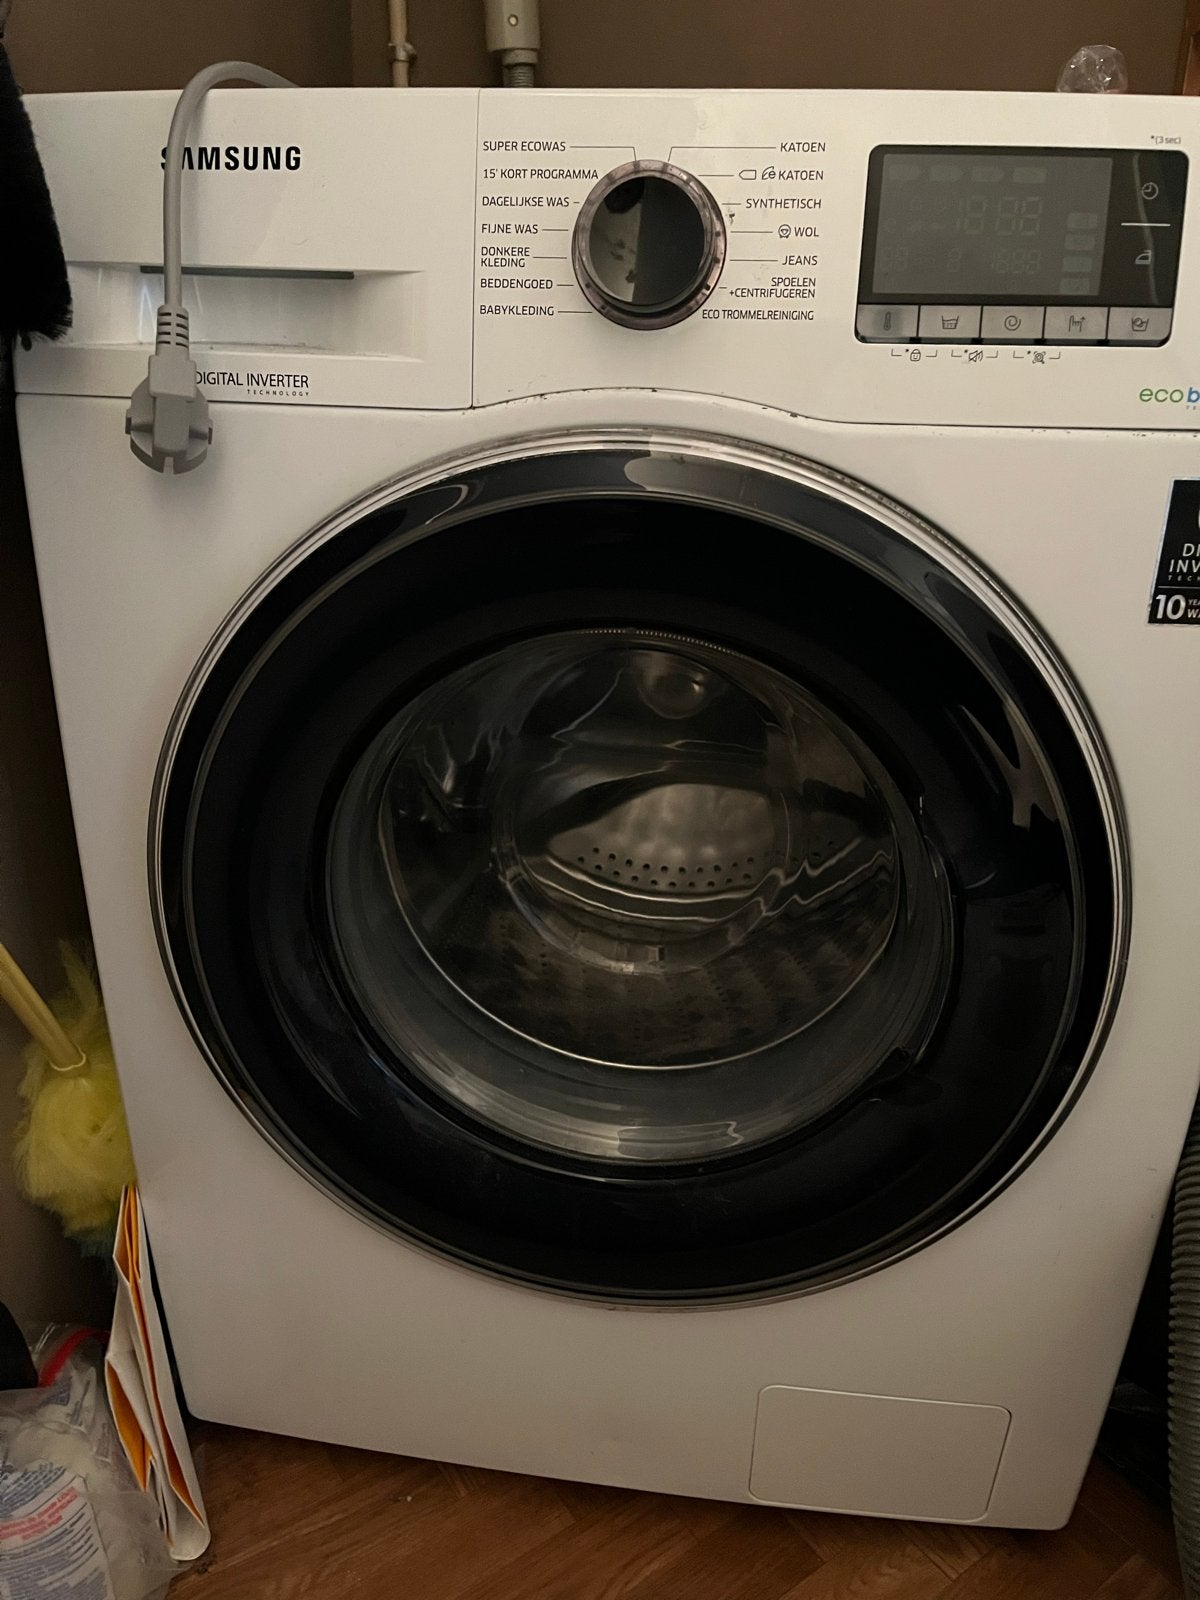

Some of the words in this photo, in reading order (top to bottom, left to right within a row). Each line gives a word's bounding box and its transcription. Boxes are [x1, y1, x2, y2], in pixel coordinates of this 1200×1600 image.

[483, 141, 518, 151] SUPER
[521, 142, 566, 151] ECOWAS
[780, 142, 826, 153] KATOEN
[161, 146, 301, 171] AMSUNG
[500, 169, 528, 179] KORT
[530, 169, 599, 180] PROGRAMMA
[778, 170, 824, 181] KATOEN
[482, 196, 544, 207] DAGELIJKSE
[546, 197, 570, 207] WAS
[746, 198, 822, 209] SYNTHETISCH
[481, 224, 512, 234] FIJNE
[514, 224, 539, 235] WAS
[794, 227, 819, 238] WOL
[481, 246, 530, 257] DONKERE
[480, 258, 526, 268] KLEDING
[782, 255, 818, 266] JEANS
[480, 278, 553, 290] BEDDENGOED
[771, 277, 816, 288] SPOELEN
[729, 287, 816, 299] +CENTRIFUGEREN
[479, 304, 555, 316] BABYKLEDING
[702, 309, 720, 319] ECO
[722, 309, 814, 321] TROMMELREINIGING
[246, 373, 309, 388] INVERTER
[247, 389, 309, 397] TECHNOLOGY
[1155, 594, 1186, 620] 10
